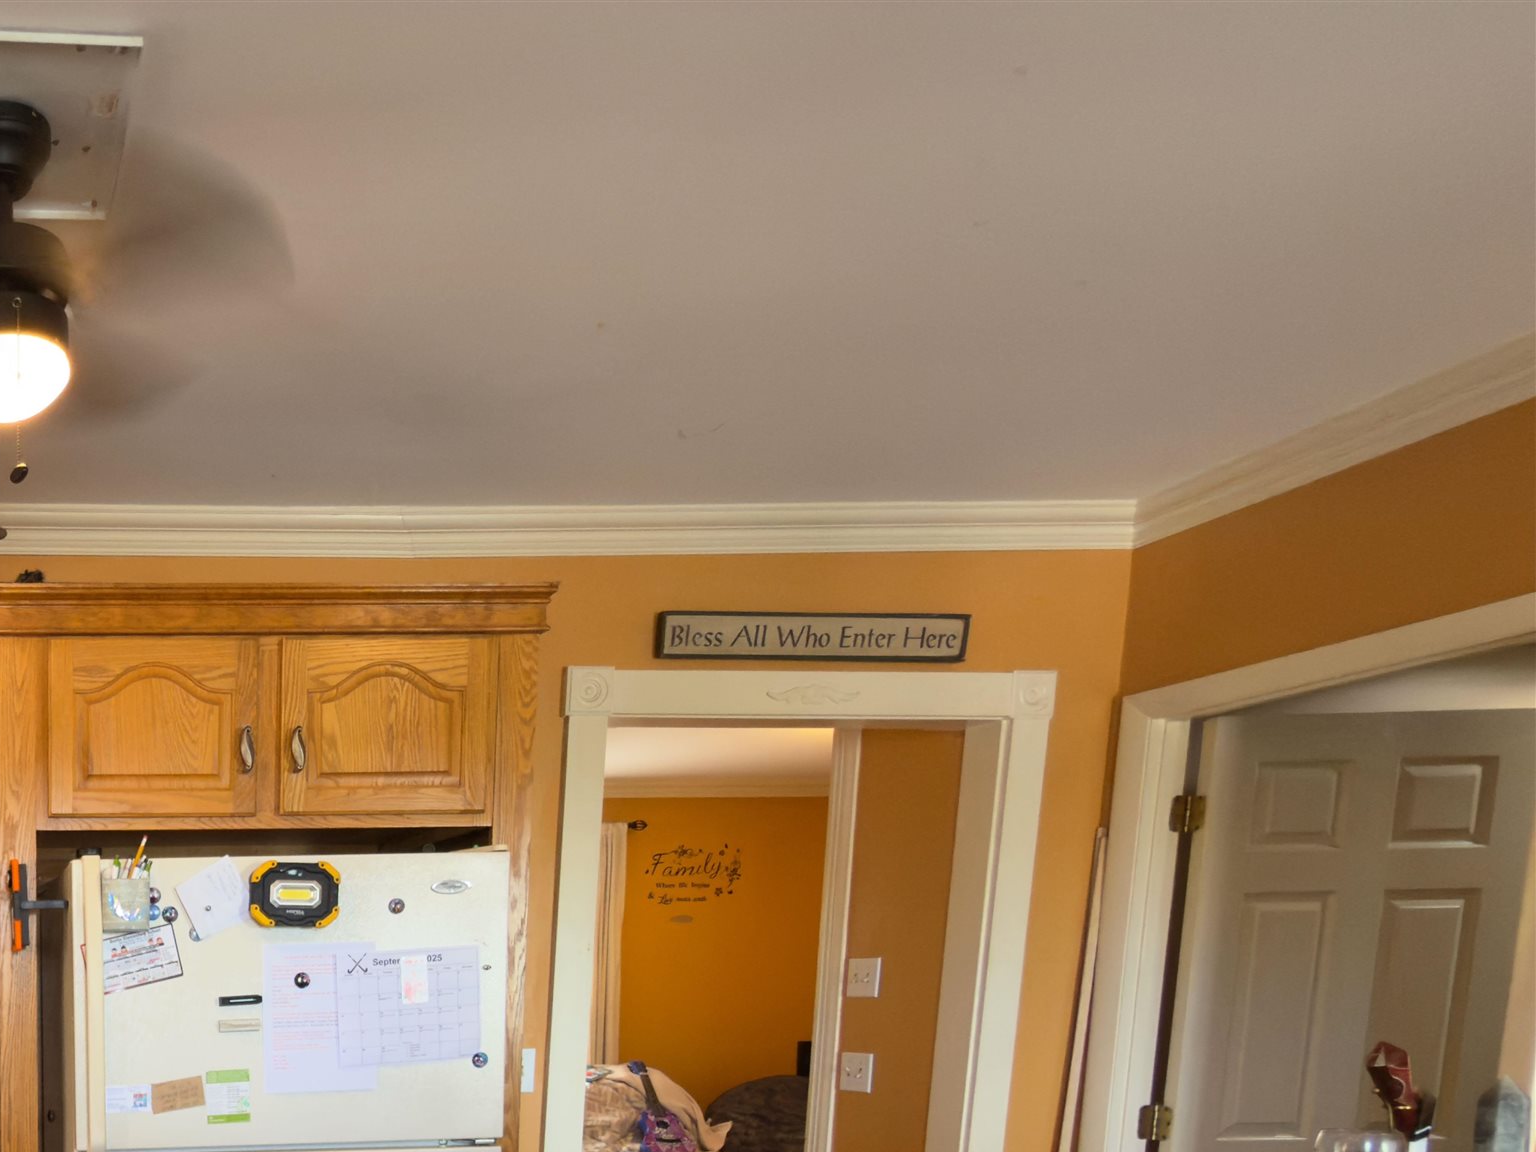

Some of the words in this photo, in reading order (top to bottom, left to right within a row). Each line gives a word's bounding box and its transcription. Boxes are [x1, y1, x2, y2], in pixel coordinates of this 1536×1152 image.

[670, 624, 724, 648] Bless
[730, 624, 768, 648] All
[777, 624, 831, 649] Who
[839, 625, 896, 649] Enter
[903, 625, 957, 649] Here
[651, 852, 722, 879] Family
[372, 957, 401, 967] Septe
[426, 953, 443, 962] 025
